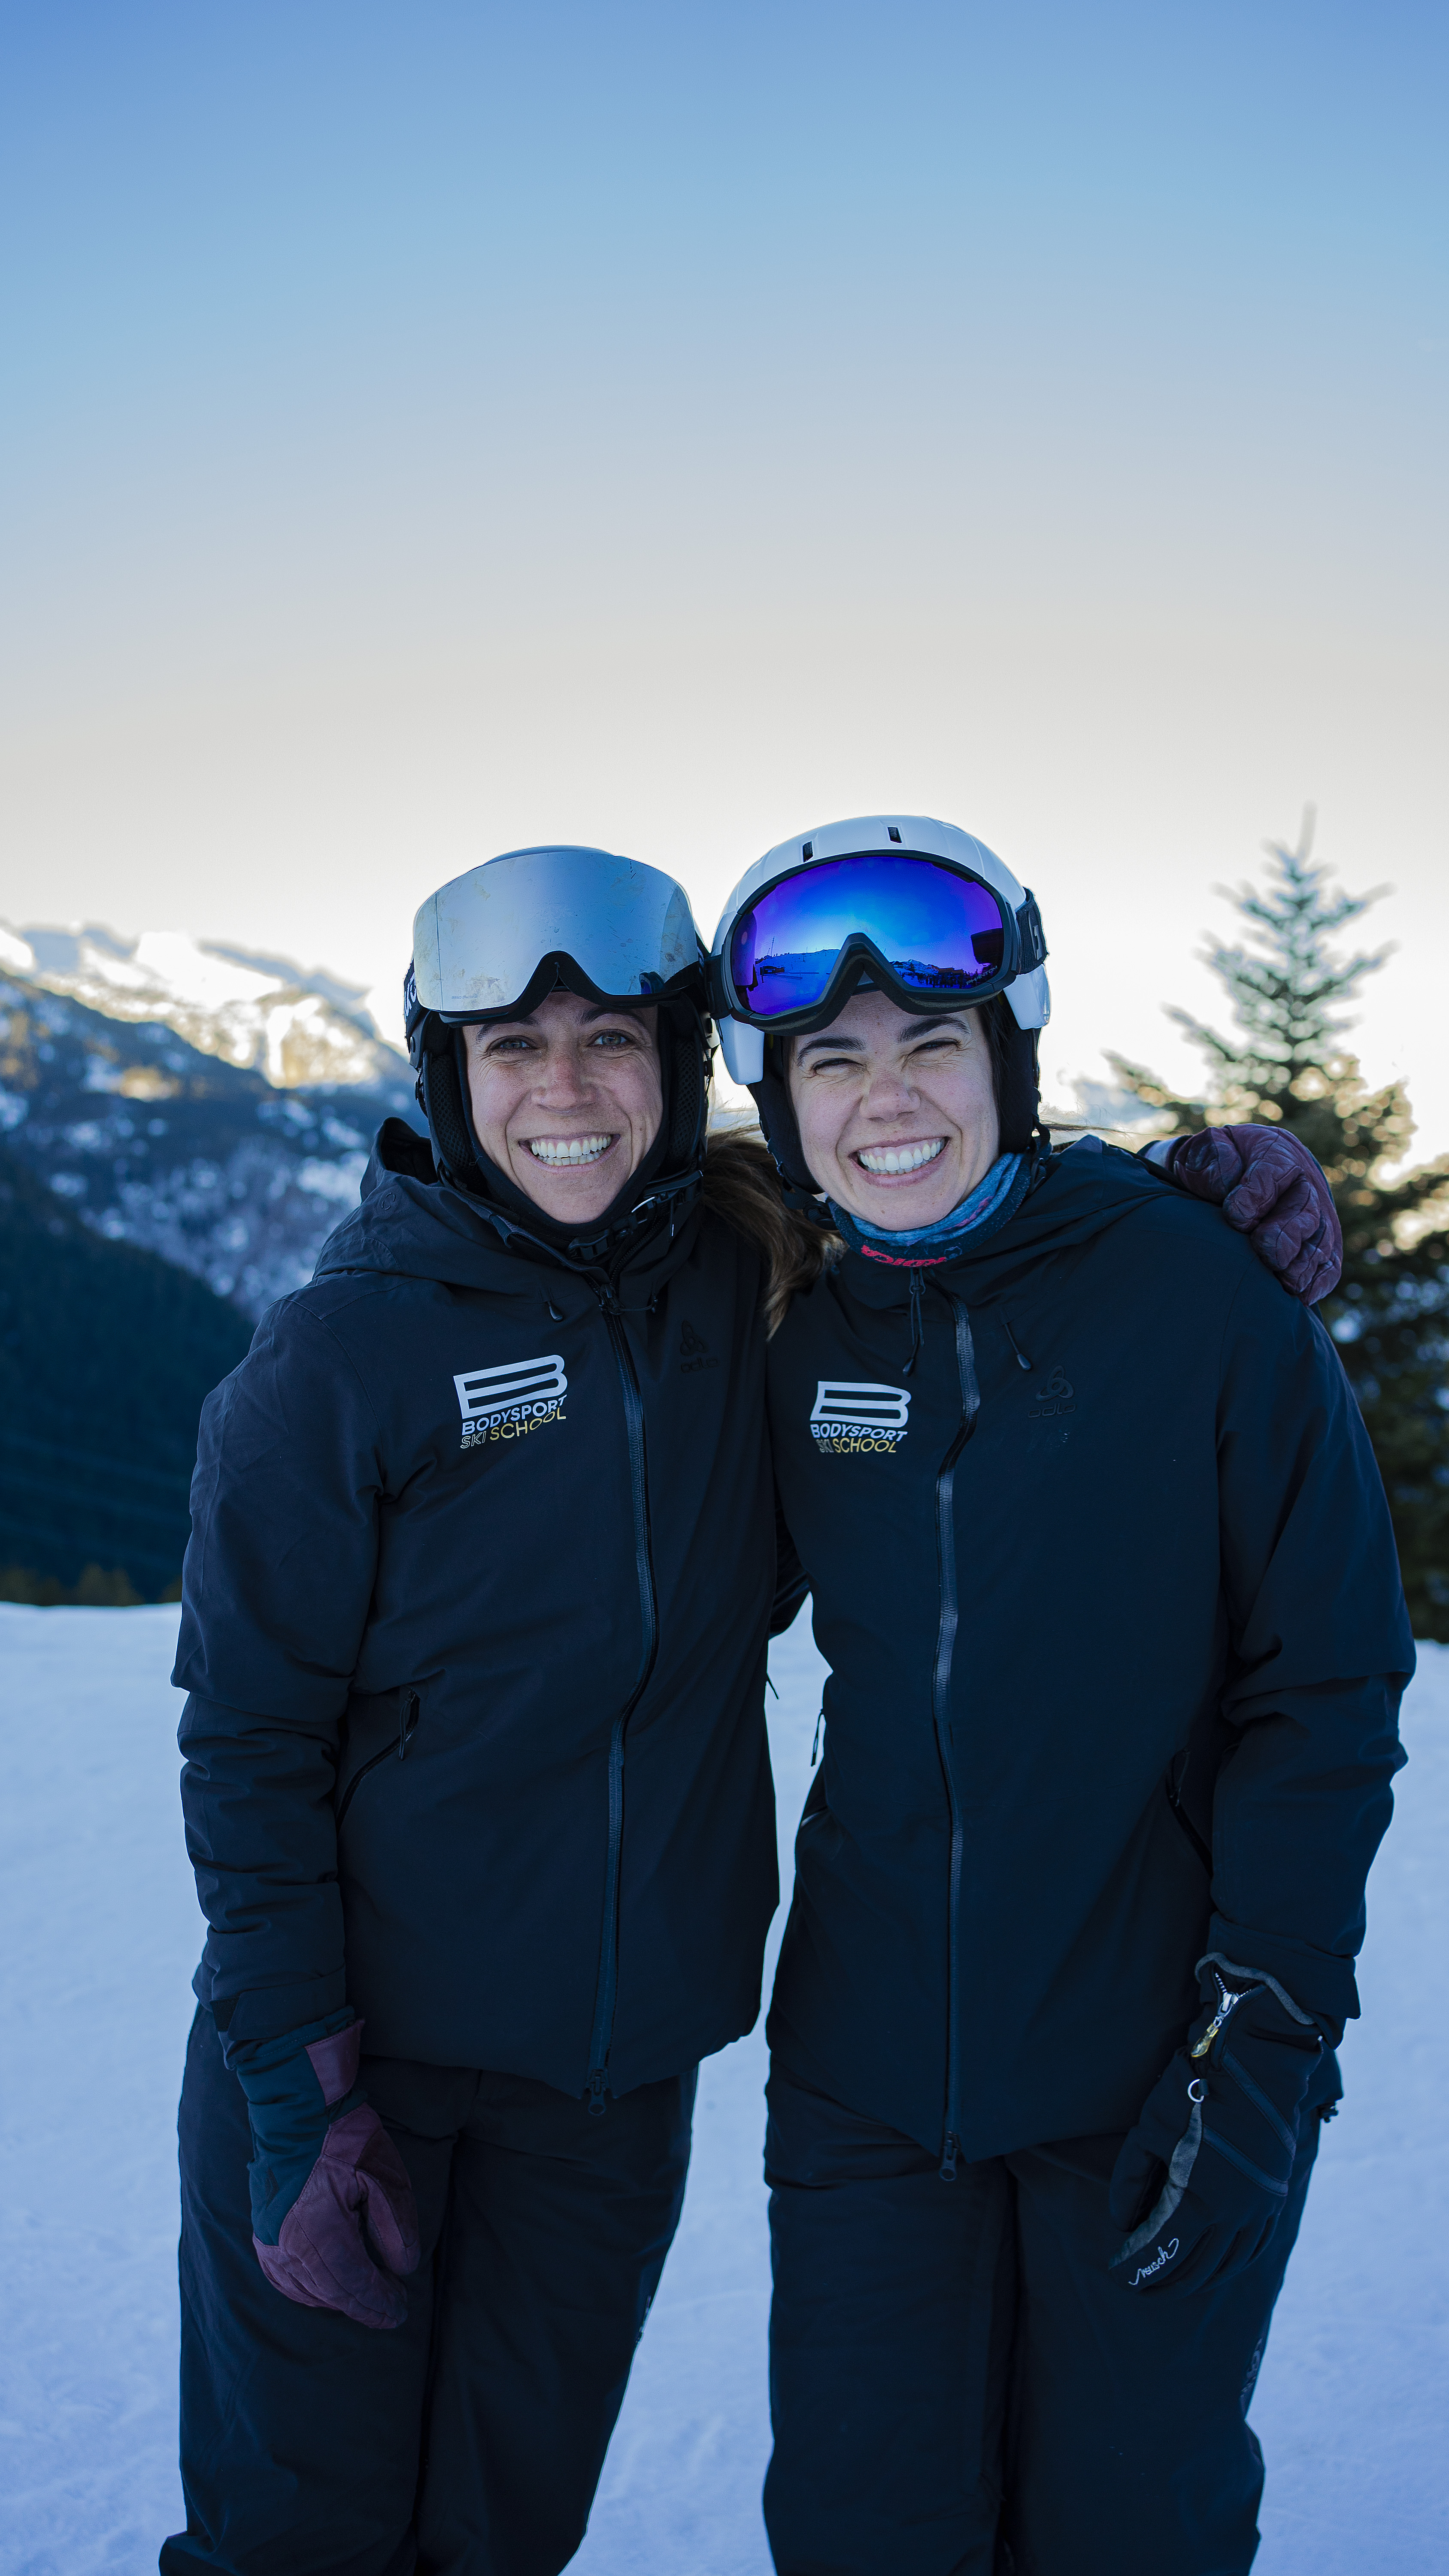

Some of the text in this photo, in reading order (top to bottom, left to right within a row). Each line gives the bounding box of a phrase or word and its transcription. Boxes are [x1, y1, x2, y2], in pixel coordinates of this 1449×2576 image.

[967, 966, 997, 985] PHANTOM
[462, 1394, 567, 1435] BODYSPORT
[1028, 1403, 1076, 1419] odlo
[460, 1407, 567, 1449] SKI SCHOOL
[810, 1423, 908, 1442] BODYSPORT
[816, 1437, 897, 1453] SKI SCHOOL
